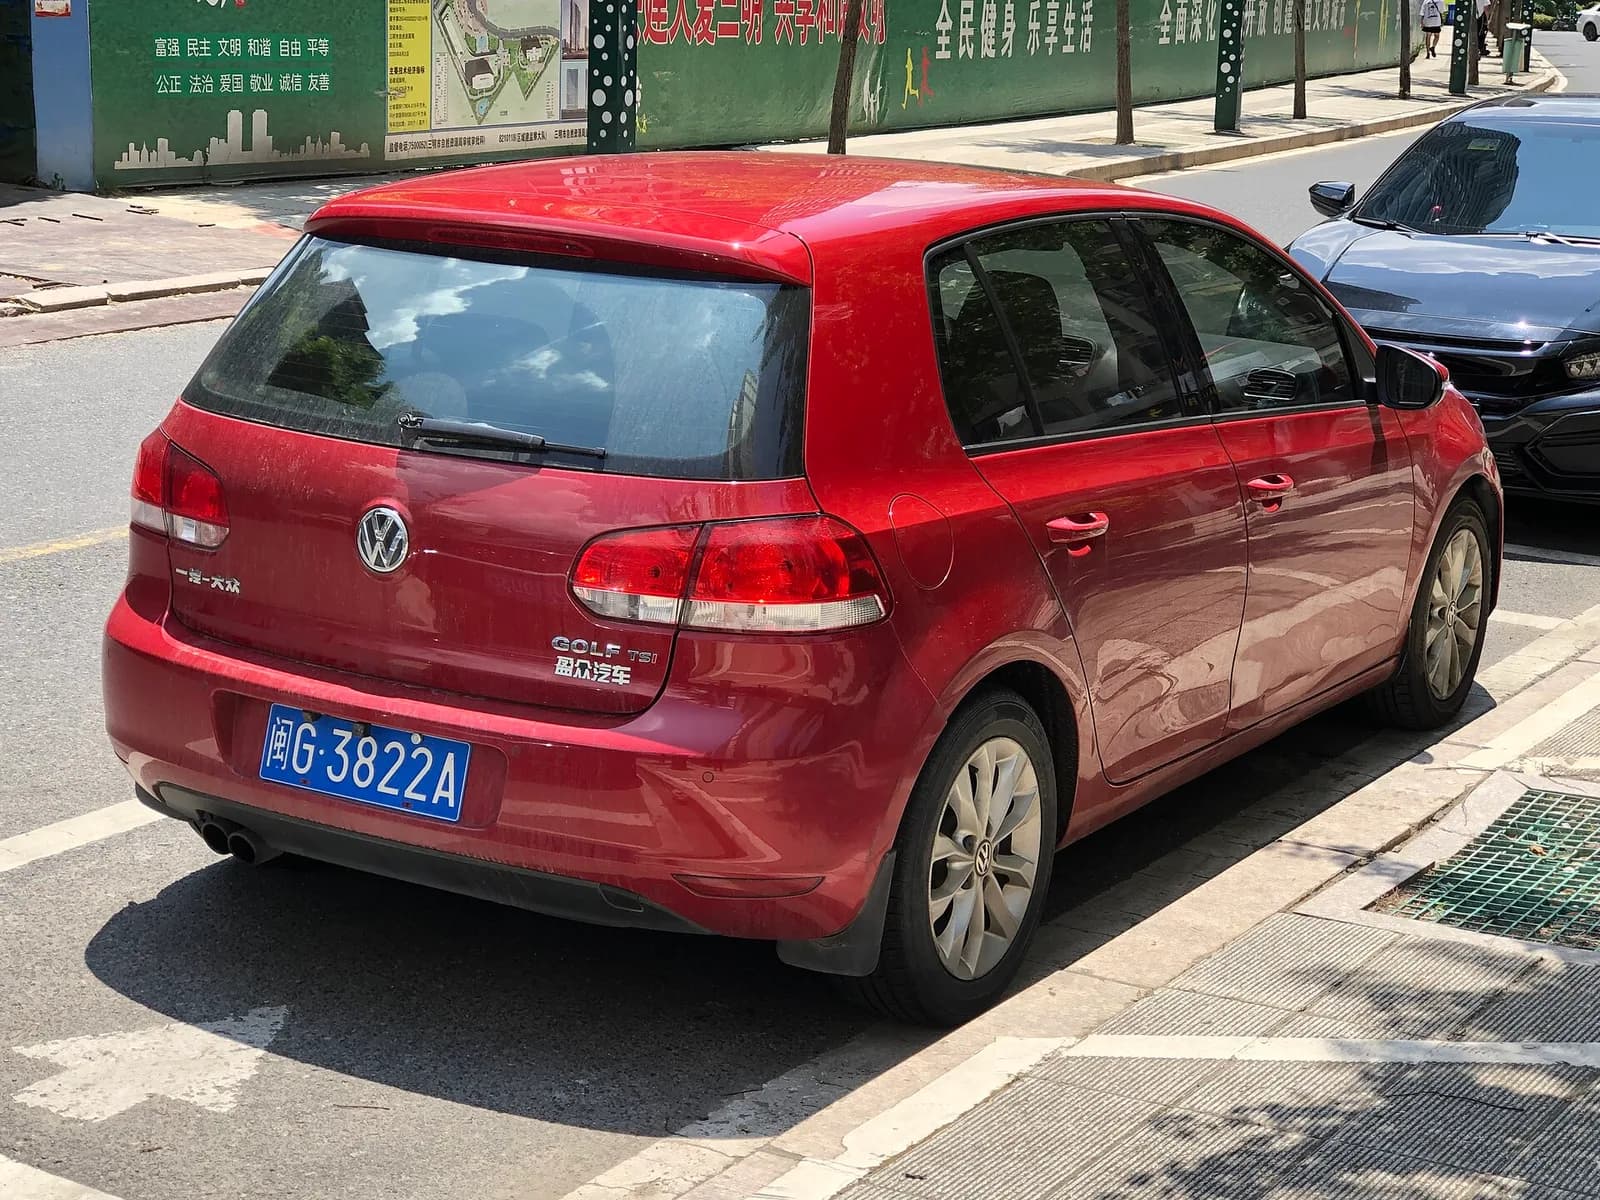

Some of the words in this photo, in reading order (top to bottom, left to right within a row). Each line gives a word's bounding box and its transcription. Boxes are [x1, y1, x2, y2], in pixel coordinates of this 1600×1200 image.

[935, 0, 1016, 59] 全民健身
[1027, 0, 1093, 56] 乐享生活
[154, 38, 180, 57] 富强
[187, 38, 211, 57] 民主
[217, 38, 241, 57] 文明
[247, 38, 271, 57] 和谐
[279, 39, 301, 57] 自由
[307, 38, 329, 57] 平等
[155, 75, 181, 94] 公正
[189, 75, 213, 93] 法治
[219, 74, 243, 93] 爱国
[249, 74, 273, 92] 敬业
[279, 73, 302, 92] 诚信
[307, 73, 330, 91] 友善
[551, 636, 621, 658] GOLF
[627, 649, 658, 664] TSI
[554, 655, 632, 685] 盈众汽车
